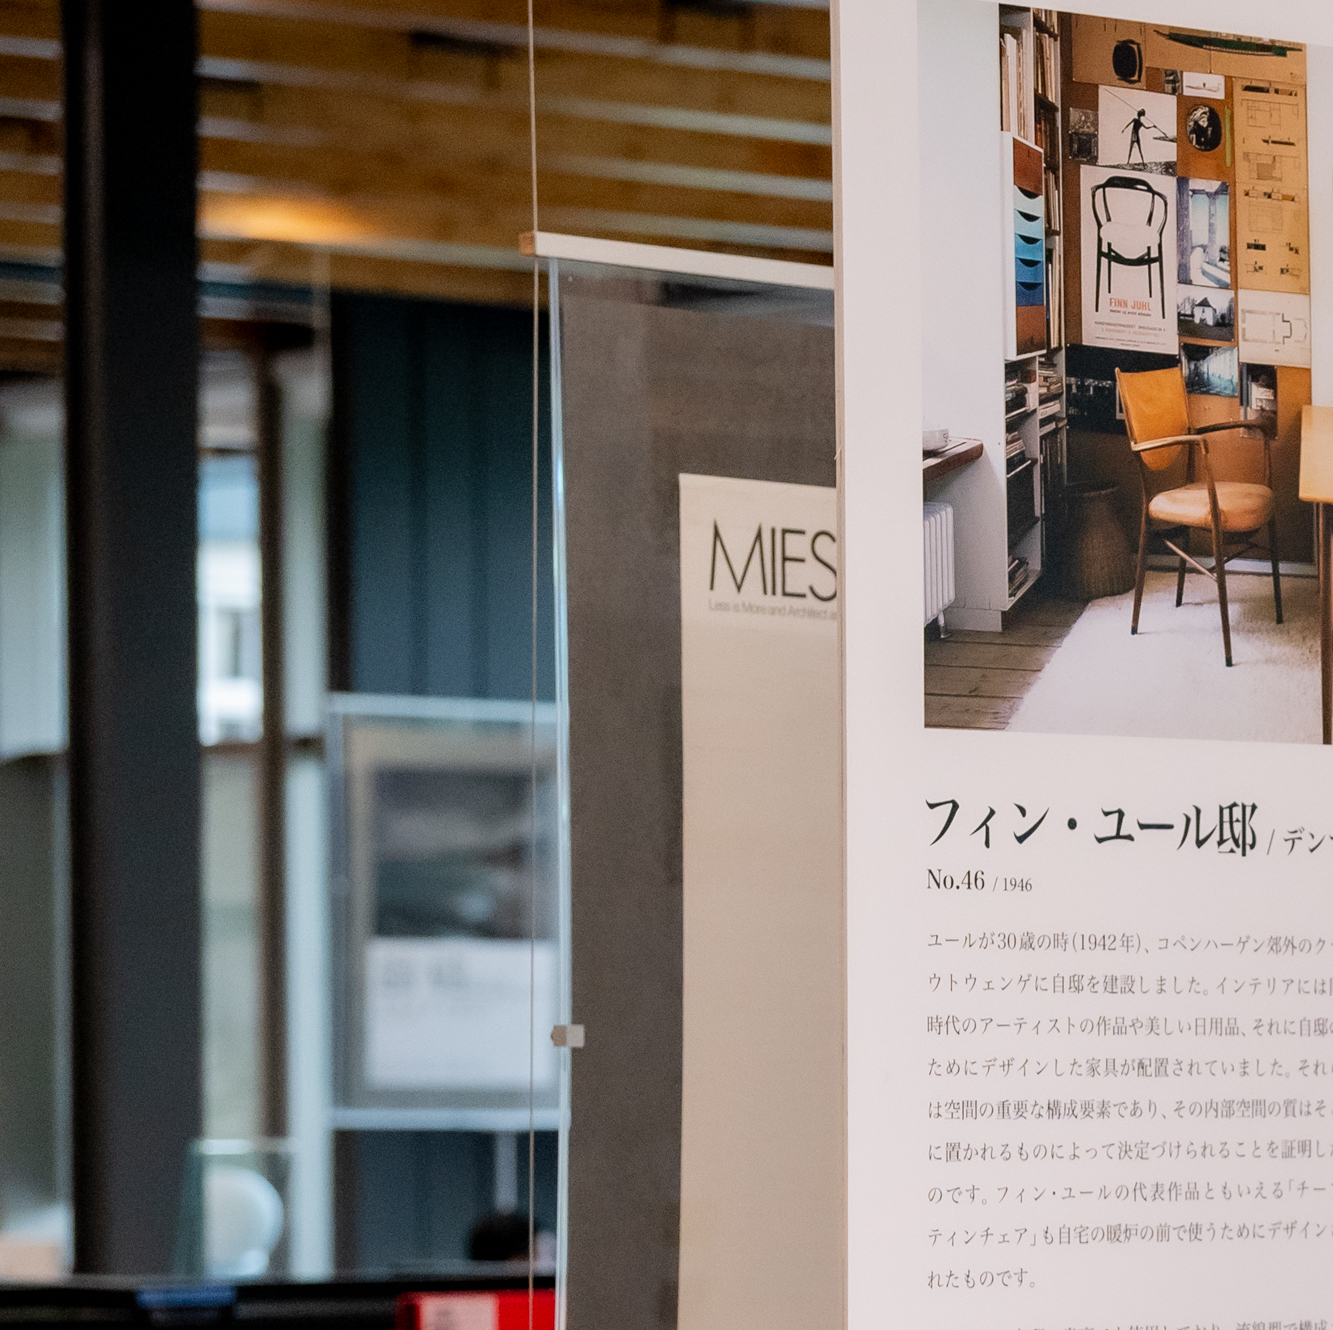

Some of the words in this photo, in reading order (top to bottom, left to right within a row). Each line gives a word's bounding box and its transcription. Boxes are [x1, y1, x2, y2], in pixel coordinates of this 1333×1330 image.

[1109, 297, 1128, 309] FINN
[1131, 300, 1152, 312] JUHL
[709, 518, 837, 602] MIES
[925, 798, 1258, 857] フィン・ユール邸
[926, 868, 986, 891] No.46
[1002, 876, 1033, 893] 1946
[927, 1267, 1037, 1291] れたものです。
